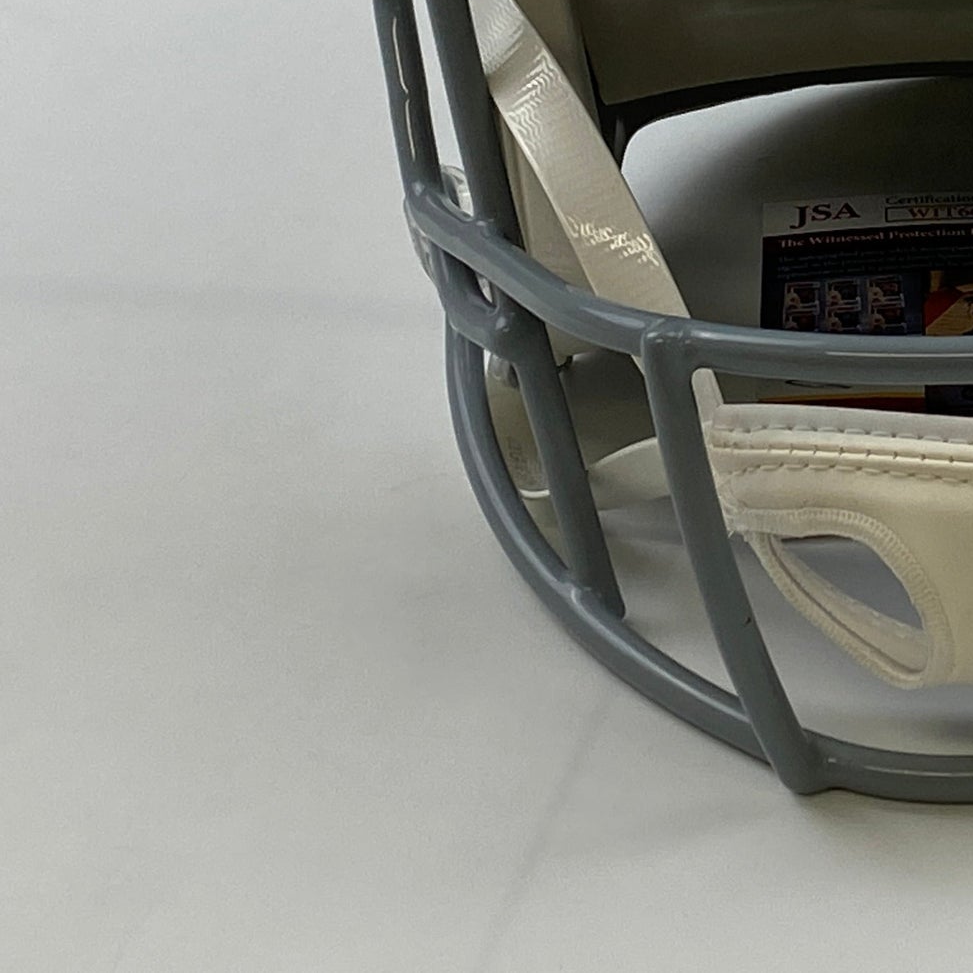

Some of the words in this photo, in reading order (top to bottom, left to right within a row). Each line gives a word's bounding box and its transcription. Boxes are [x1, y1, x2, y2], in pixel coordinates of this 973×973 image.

[790, 203, 860, 229] JSA
[779, 238, 803, 248] The
[808, 232, 885, 245] Witnessed
[889, 229, 966, 240] Protection
